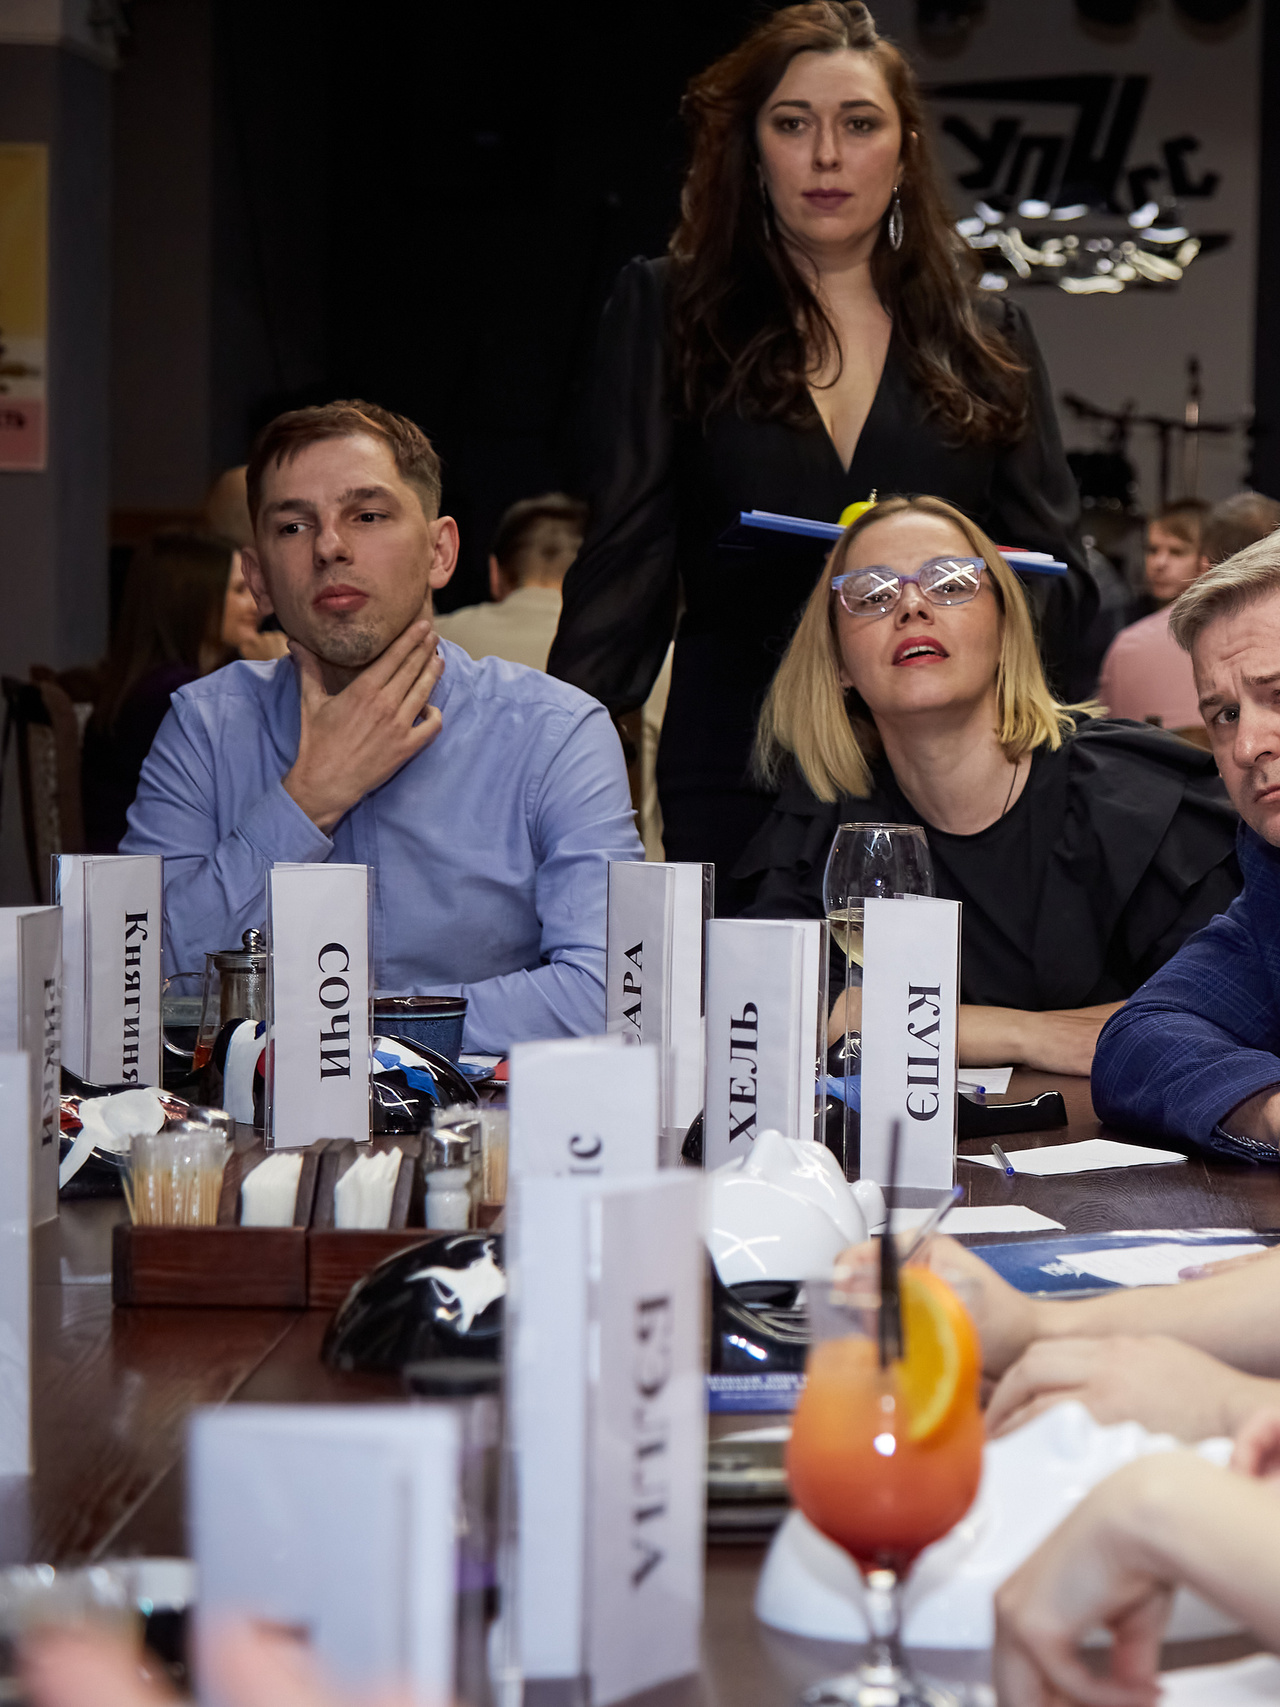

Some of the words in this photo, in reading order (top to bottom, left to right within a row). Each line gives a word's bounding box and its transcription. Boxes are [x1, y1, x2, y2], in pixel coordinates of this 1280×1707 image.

[122, 909, 149, 1084] Княгиня
[317, 942, 351, 1083] СОЧИ
[905, 981, 942, 1122] КУПЭ
